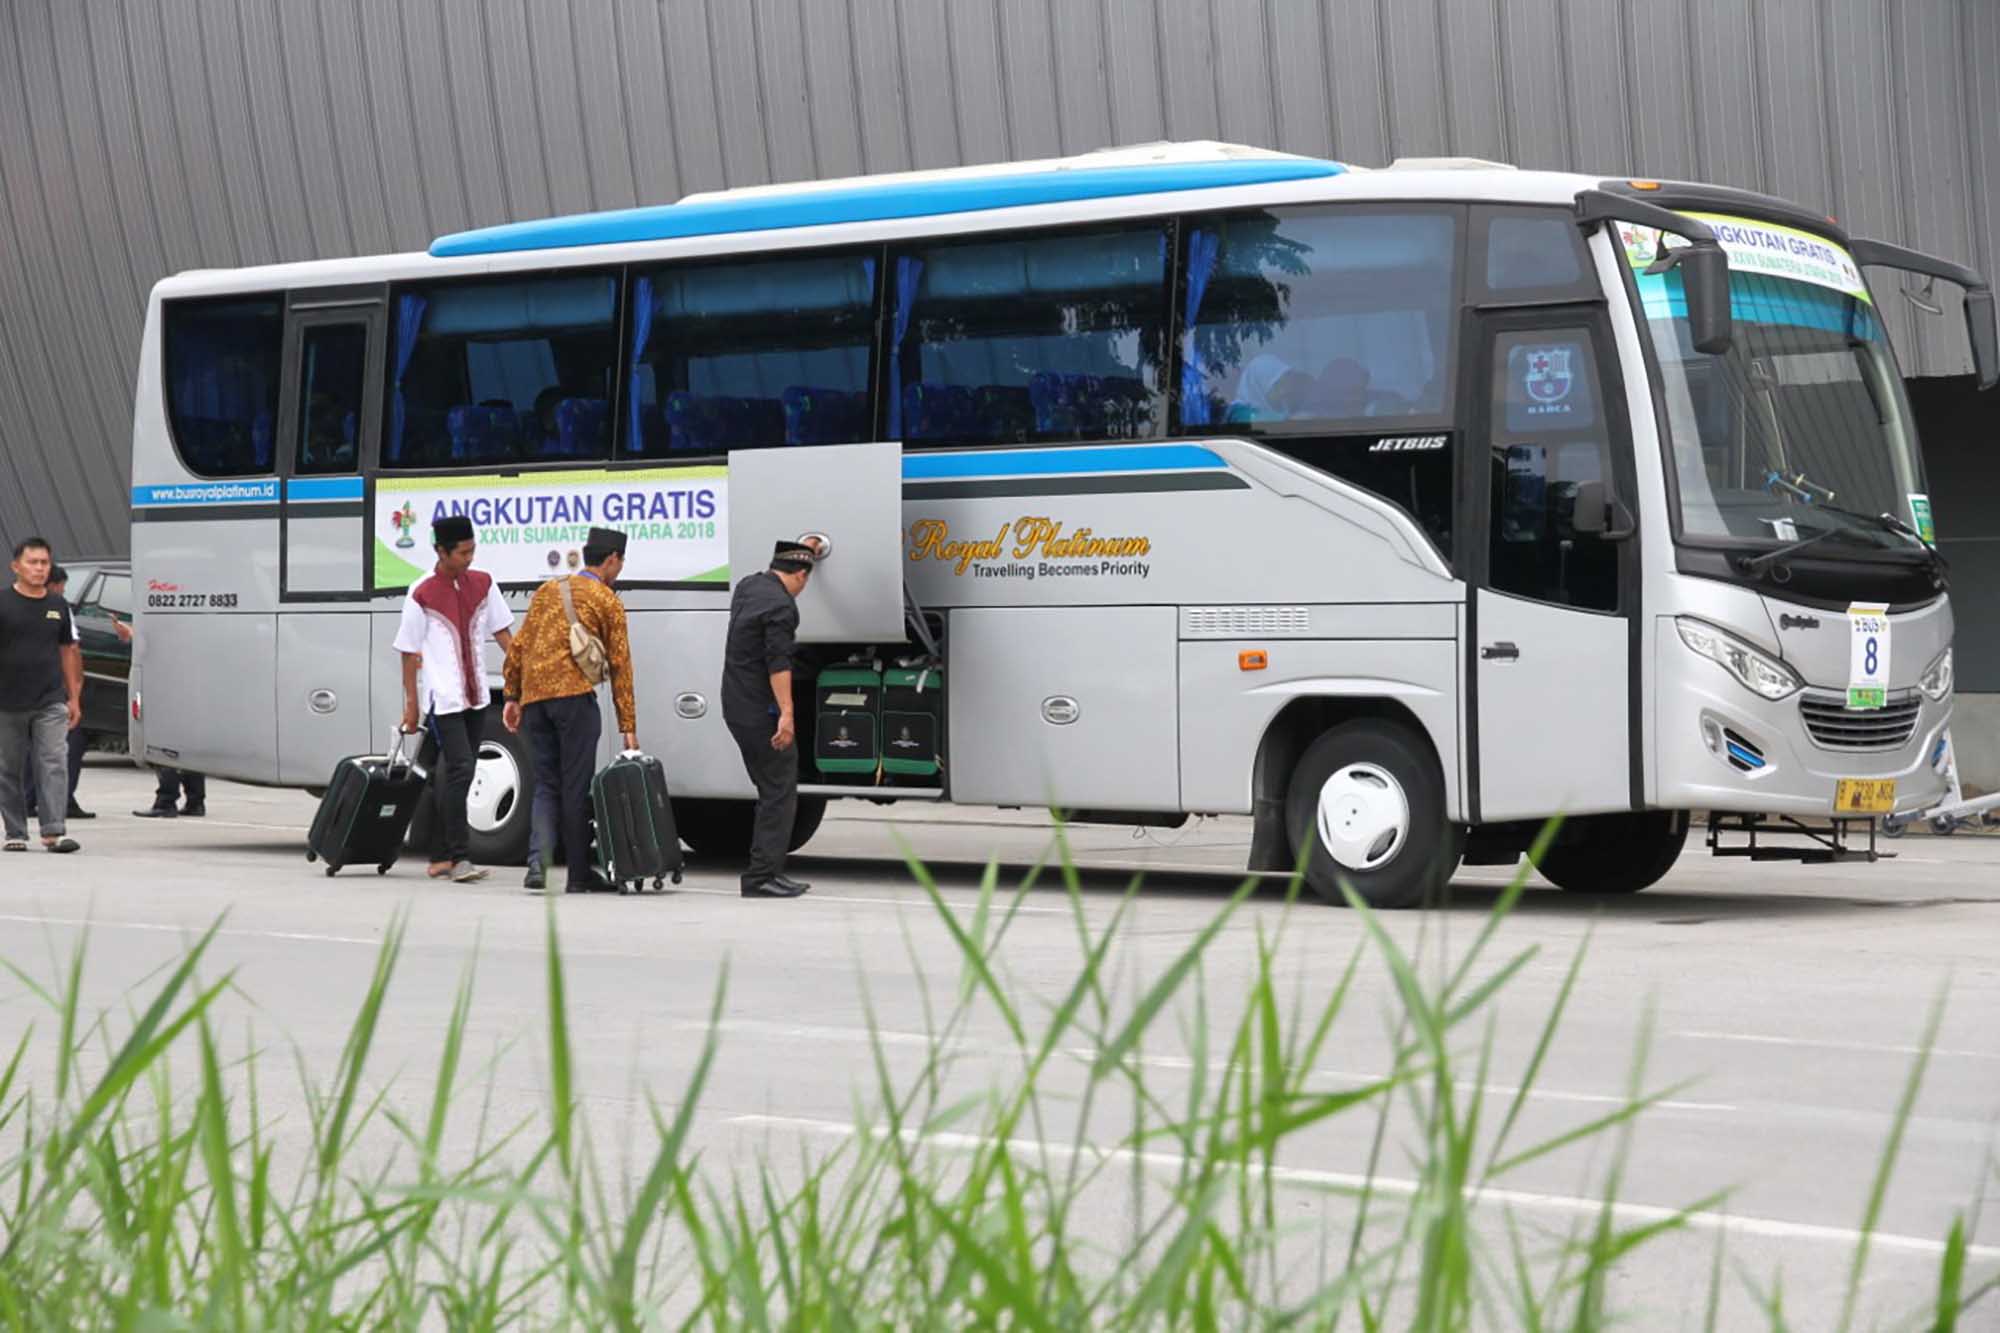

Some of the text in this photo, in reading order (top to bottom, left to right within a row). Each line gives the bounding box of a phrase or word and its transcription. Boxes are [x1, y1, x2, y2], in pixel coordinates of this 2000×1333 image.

[1709, 225, 1837, 265] NGKUTAN GRATIS
[1368, 436, 1448, 451] JETBUS
[150, 483, 275, 501] www.busroyalplatinum.id
[602, 489, 716, 522] GRATIS
[479, 528, 519, 545] XXVII
[523, 523, 611, 543] SUMATE
[677, 521, 715, 540] 2018
[909, 518, 1011, 576] Royal
[1012, 515, 1152, 560] Platinum
[973, 560, 1151, 580] Travelling Becomes Priority
[147, 593, 239, 608] 0822 2727 8833
[1864, 636, 1878, 676] 8
